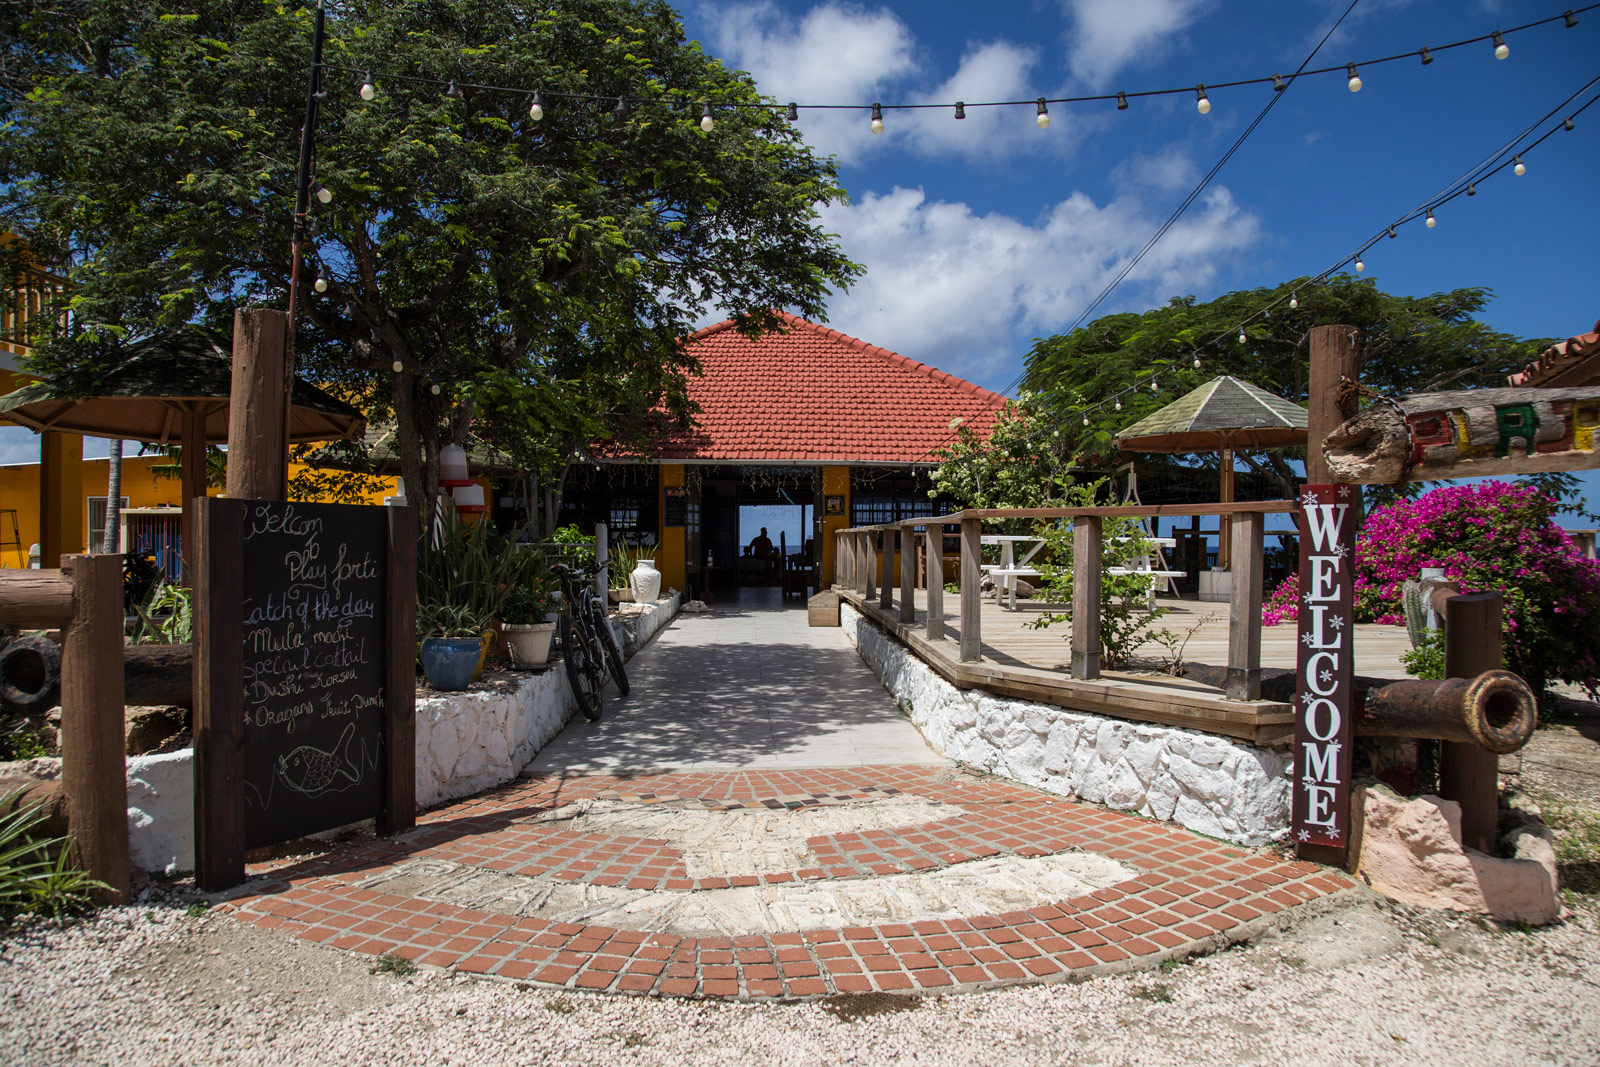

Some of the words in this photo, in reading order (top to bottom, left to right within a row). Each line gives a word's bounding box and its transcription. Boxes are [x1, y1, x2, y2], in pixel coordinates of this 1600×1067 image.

[243, 592, 293, 625] Catch
[296, 592, 311, 632] of
[312, 590, 339, 621] the
[341, 592, 374, 619] day
[248, 622, 304, 653] Mula
[1302, 503, 1350, 827] WELCOME
